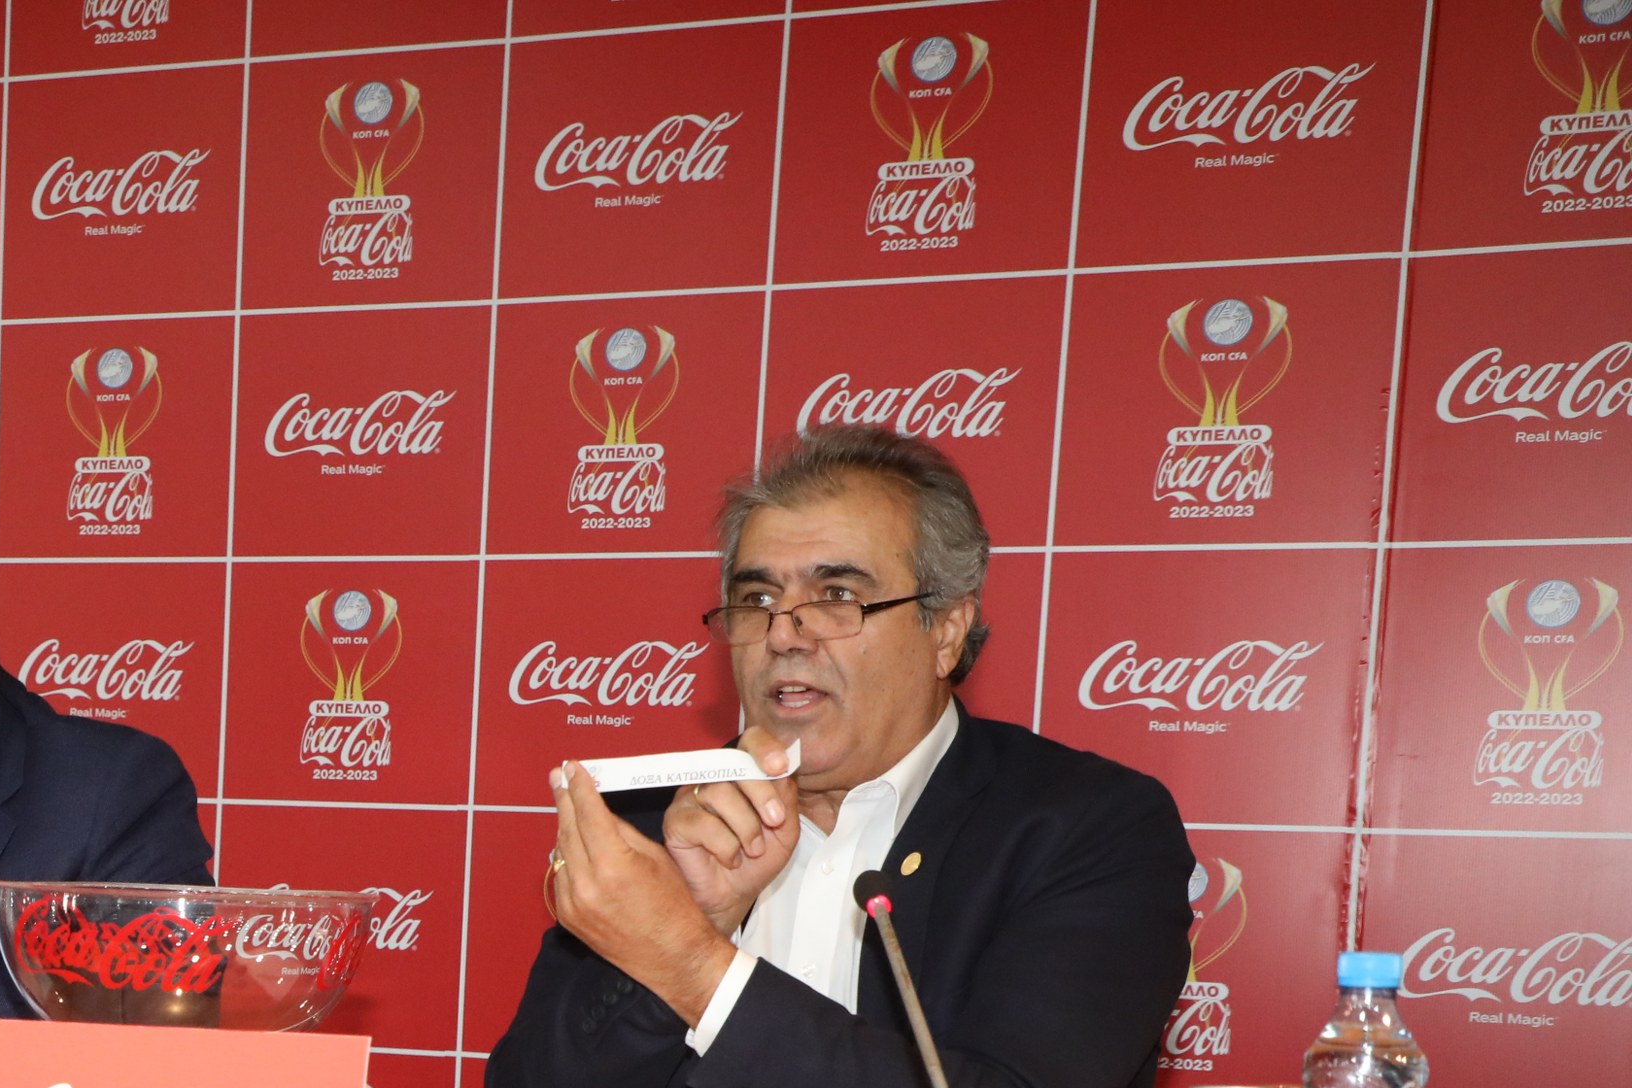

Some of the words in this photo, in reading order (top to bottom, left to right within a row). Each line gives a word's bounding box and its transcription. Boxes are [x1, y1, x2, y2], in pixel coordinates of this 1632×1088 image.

[93, 28, 158, 45] 2022-2023
[1123, 63, 1375, 150] Coca-Cola
[1550, 113, 1632, 132] ΚΥΠΕΛΛ
[535, 112, 741, 191] Coca-Cola
[1194, 155, 1227, 168] Real
[1230, 152, 1275, 167] Magic
[1524, 130, 1632, 196] Coca-Co
[887, 161, 965, 177] ΚΥΠΕΛΛΟ
[32, 149, 210, 220] Coca-Cola
[335, 197, 403, 212] ΚΥΠΕΛΛΟ
[594, 196, 622, 208] Real
[624, 193, 661, 207] Magic
[84, 225, 109, 236] Real
[110, 223, 143, 236] Magic
[879, 235, 959, 252] 2022-2023
[331, 267, 399, 281] 2022-2023
[1436, 342, 1632, 423] Coca-Co
[796, 367, 1022, 438] Coca-Cola
[265, 390, 456, 456] Coca-Cola
[1176, 428, 1262, 442] ΚΥΠΕΛΛΟ
[1515, 430, 1550, 443] Real
[1554, 428, 1602, 443] Magic
[586, 446, 656, 459] ΚΥΠΕΛΛΟ
[81, 458, 144, 470] ΚΥΠΕΛΛΟ
[321, 464, 346, 475] Real
[348, 463, 382, 476] Magic
[1169, 504, 1255, 519] 2022-2023
[79, 524, 141, 536] 2022-2023
[580, 516, 651, 529] 2022-2023
[18, 639, 195, 700] Coca-Cola
[509, 641, 708, 706] Coca-Cola
[1079, 640, 1324, 711] Coca-Cola
[69, 706, 94, 719] Real
[94, 707, 127, 720] Magic
[317, 703, 382, 714] ΚΥΠΕΛΛΟ
[567, 714, 593, 725] Real
[595, 714, 632, 728] Magic
[1148, 720, 1181, 732] Real
[1183, 720, 1227, 735] Magic
[1497, 713, 1592, 728] ΚΥΠΕΛΛΟ
[312, 768, 378, 781] 2022-2023
[1490, 792, 1583, 806] 2022-2023
[1469, 1011, 1504, 1024] Real
[1507, 1013, 1555, 1028] Magic
[1159, 1058, 1213, 1072] 2-2023
